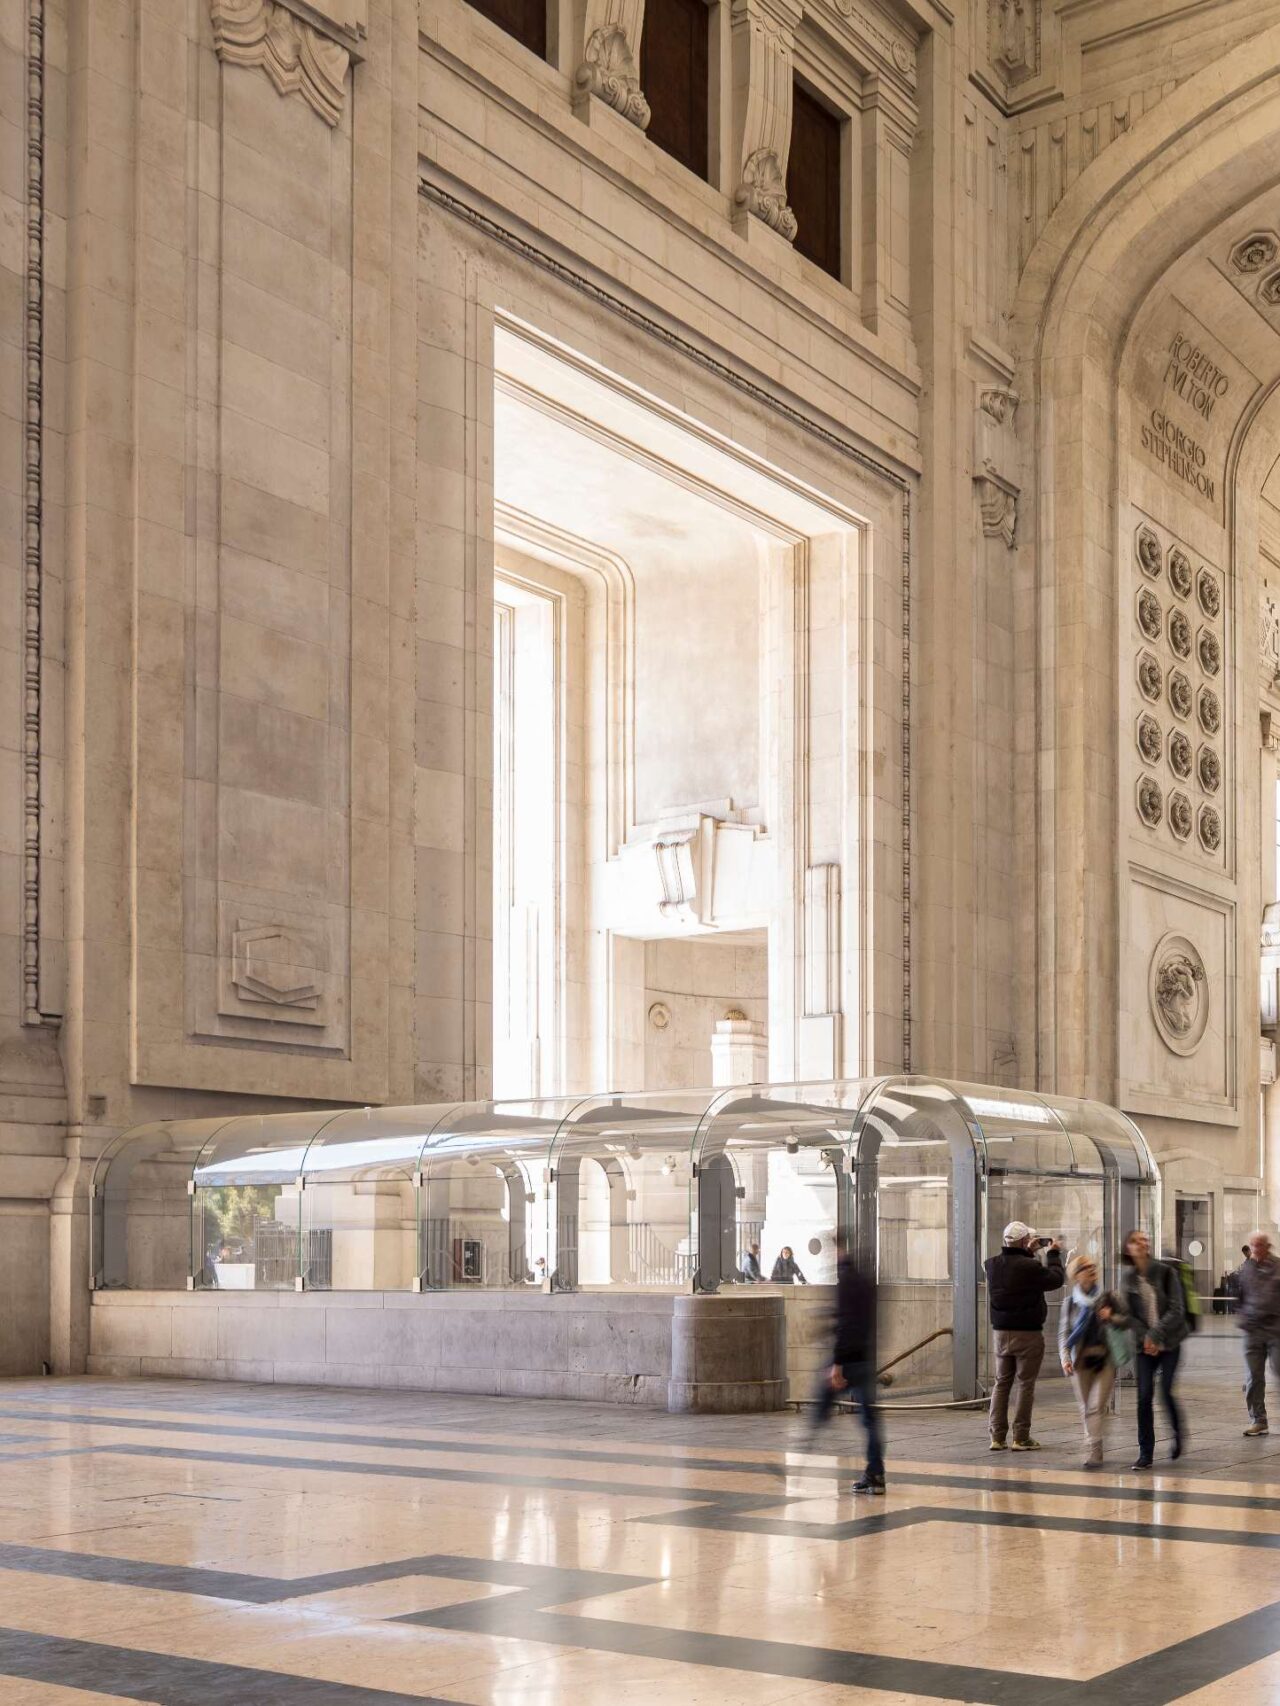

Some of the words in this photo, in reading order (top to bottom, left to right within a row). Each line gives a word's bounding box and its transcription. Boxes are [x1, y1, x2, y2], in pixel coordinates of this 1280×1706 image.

[1168, 331, 1229, 398] ROBERTO
[1141, 424, 1215, 503] STEPHENSON
[1151, 408, 1206, 468] GIORGIO
